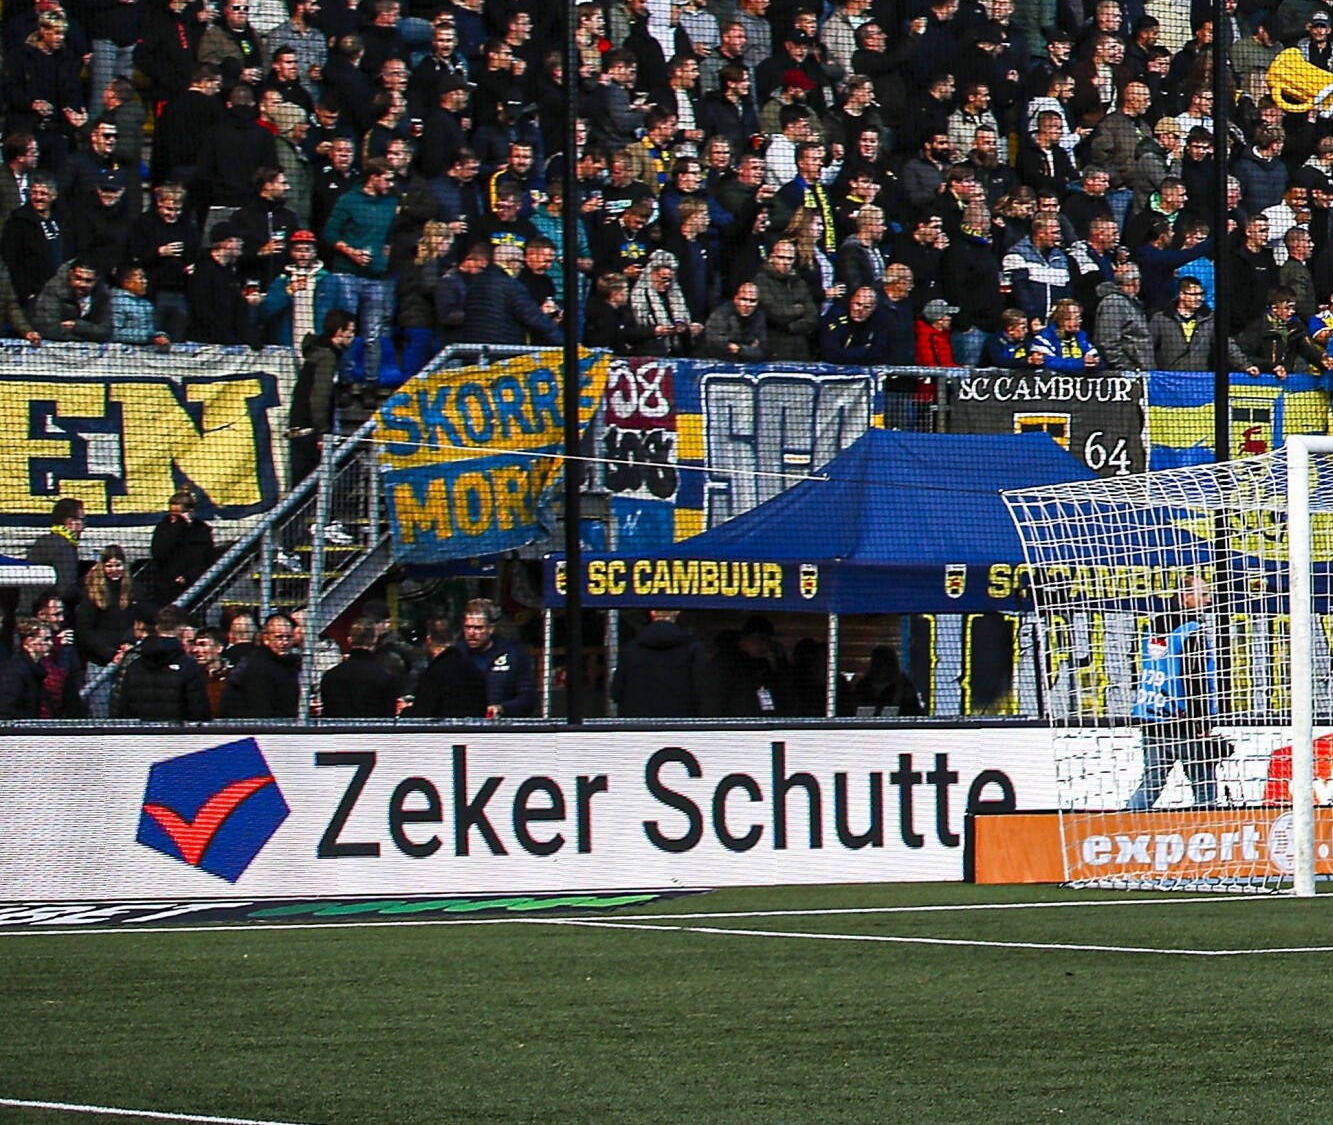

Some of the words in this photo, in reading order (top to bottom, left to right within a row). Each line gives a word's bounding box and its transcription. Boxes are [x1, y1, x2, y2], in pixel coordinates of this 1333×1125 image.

[958, 376, 991, 402] SC
[993, 375, 1133, 403] CAMBUUR
[1084, 431, 1132, 476] 64
[586, 560, 628, 596] SC
[632, 560, 783, 599] CAMBUUR
[313, 743, 609, 861] Zeker
[642, 741, 1017, 853] Schutte
